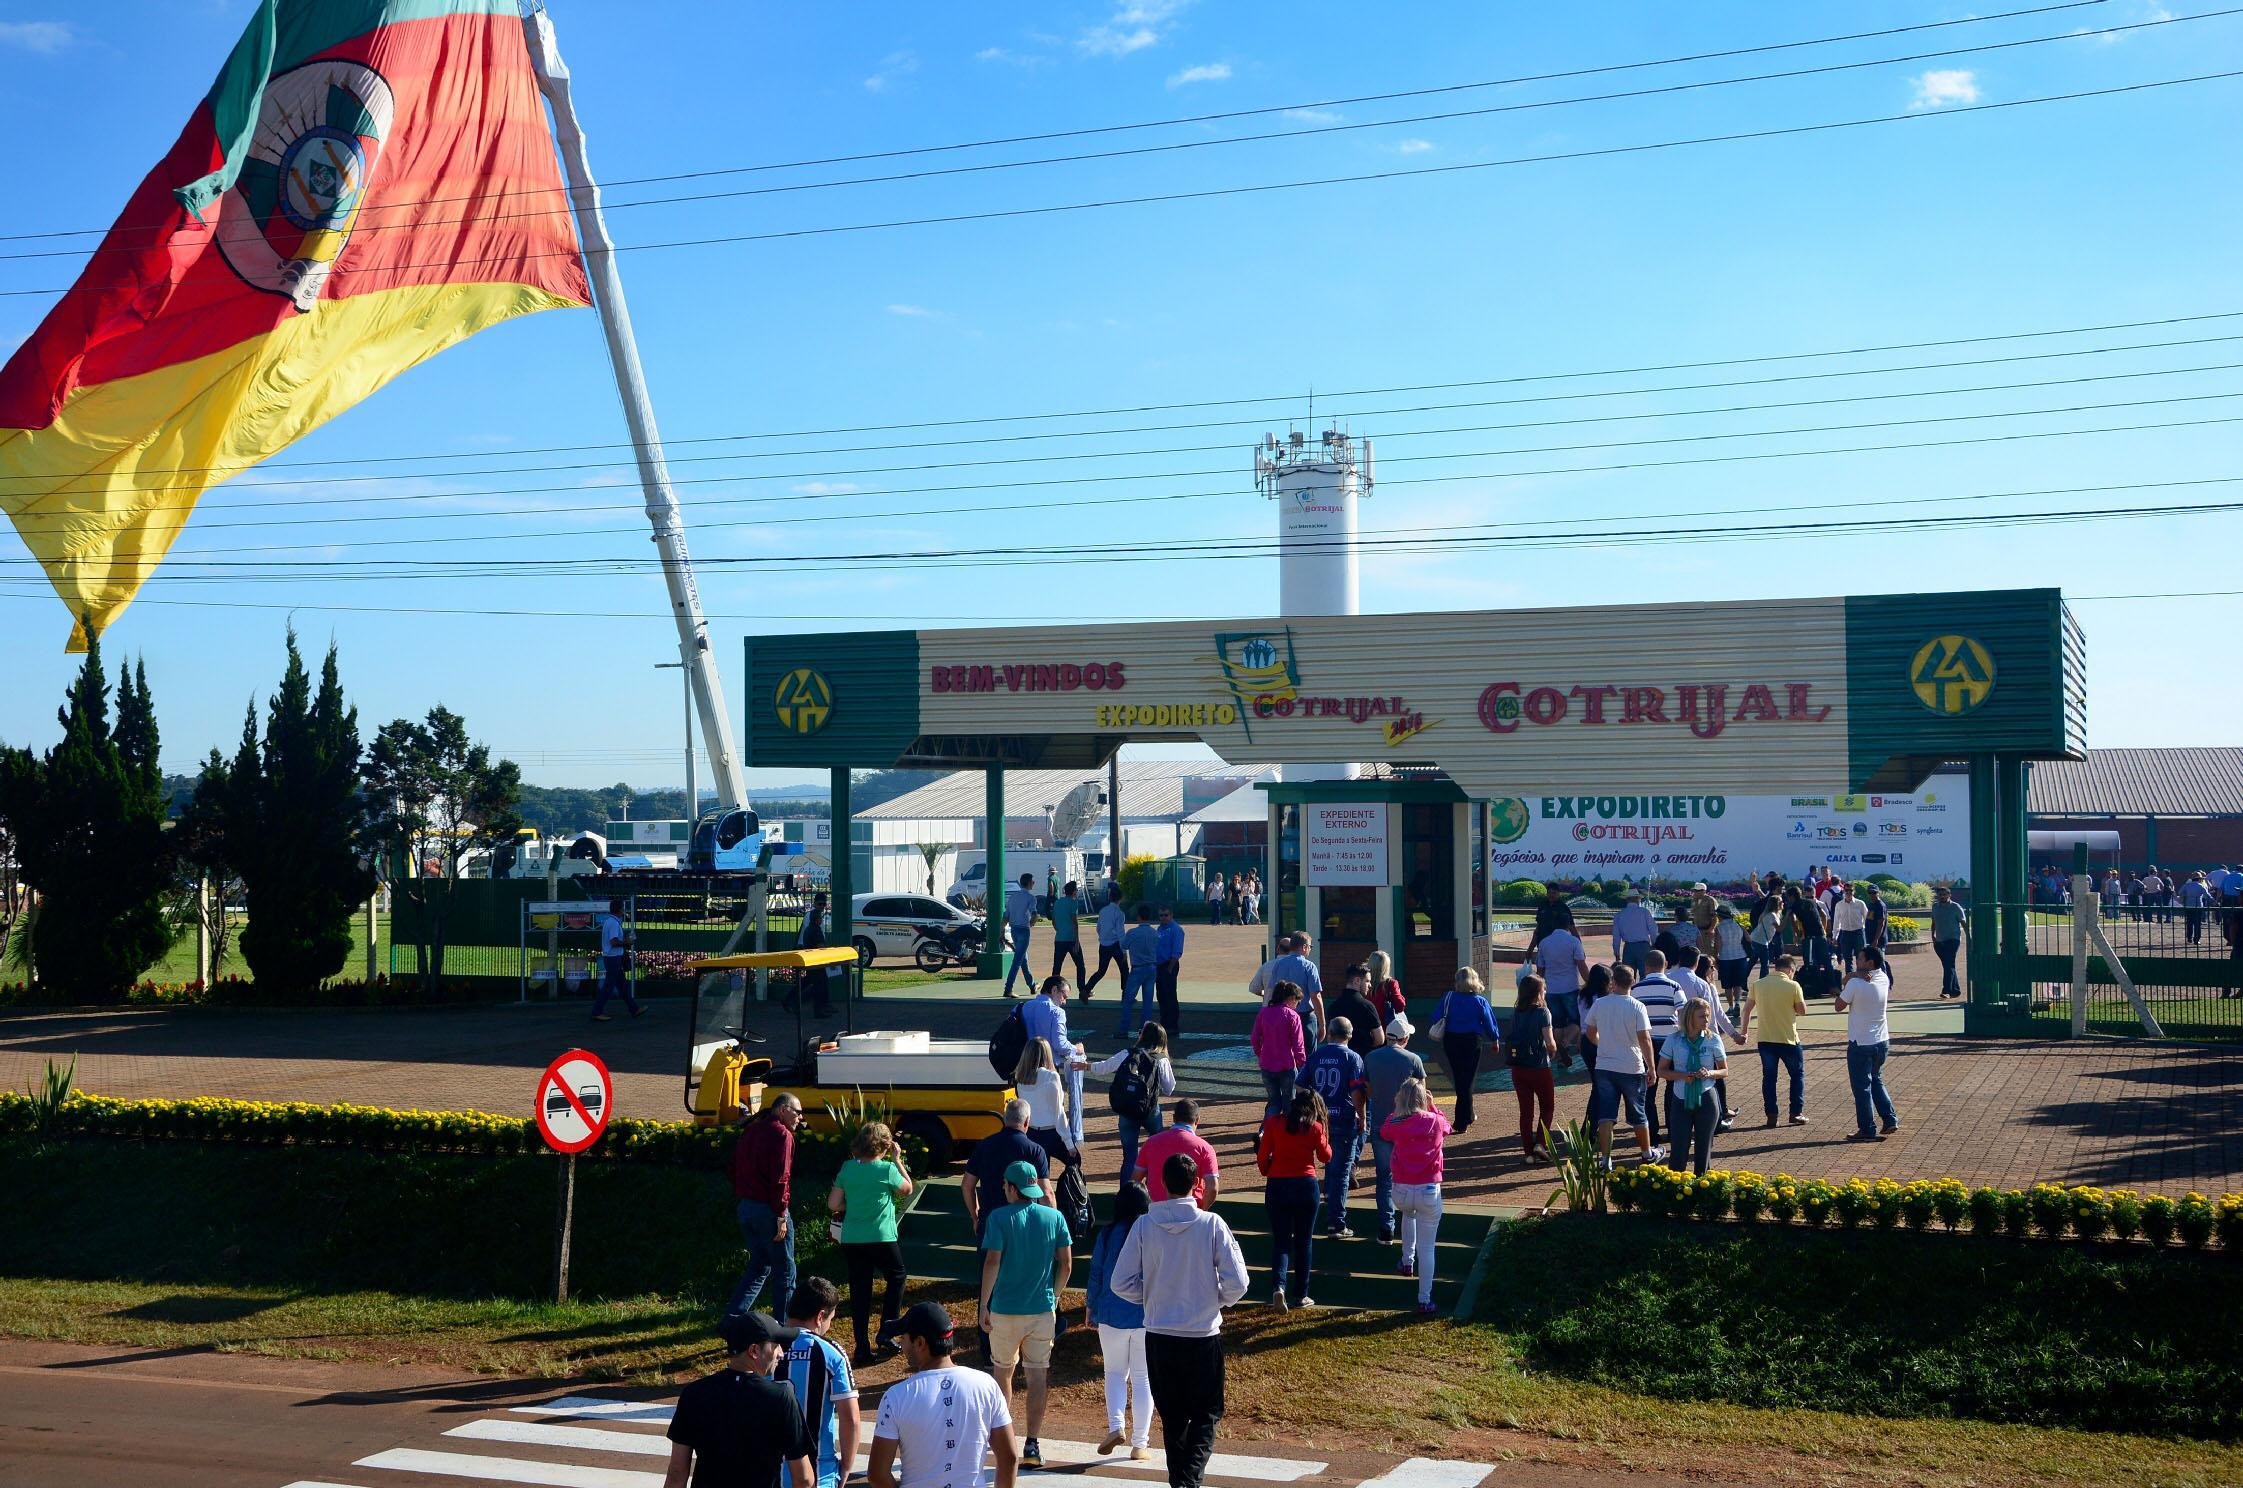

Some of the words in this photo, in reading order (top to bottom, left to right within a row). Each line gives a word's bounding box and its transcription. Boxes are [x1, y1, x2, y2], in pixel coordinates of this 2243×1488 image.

[932, 662, 1125, 693] BEM-VINDOS
[1096, 703, 1235, 728] EXPODIRETO
[1252, 693, 1411, 724] COTRIJAL
[1478, 681, 1832, 740] COTRIJAL
[1541, 795, 1726, 819] EXPODIRETO
[1790, 797, 1829, 807] BRASIL
[1320, 810, 1375, 819] EXPEDIENTE
[1325, 820, 1368, 829] EXTERNO
[1572, 822, 1695, 846] COTRIJAL
[1786, 831, 1813, 839] Banrisul
[1916, 826, 1943, 836] syngenta
[1320, 837, 1346, 846] Segunda
[1351, 836, 1383, 844] Sexta-Feira
[1552, 851, 1579, 870] que
[1583, 849, 1645, 870] inspiram
[1651, 851, 1661, 864] o
[1667, 846, 1727, 865] amanhã
[1826, 854, 1857, 863] CAIXA
[1312, 864, 1328, 872] Tarde
[1314, 1067, 1341, 1097] 99
